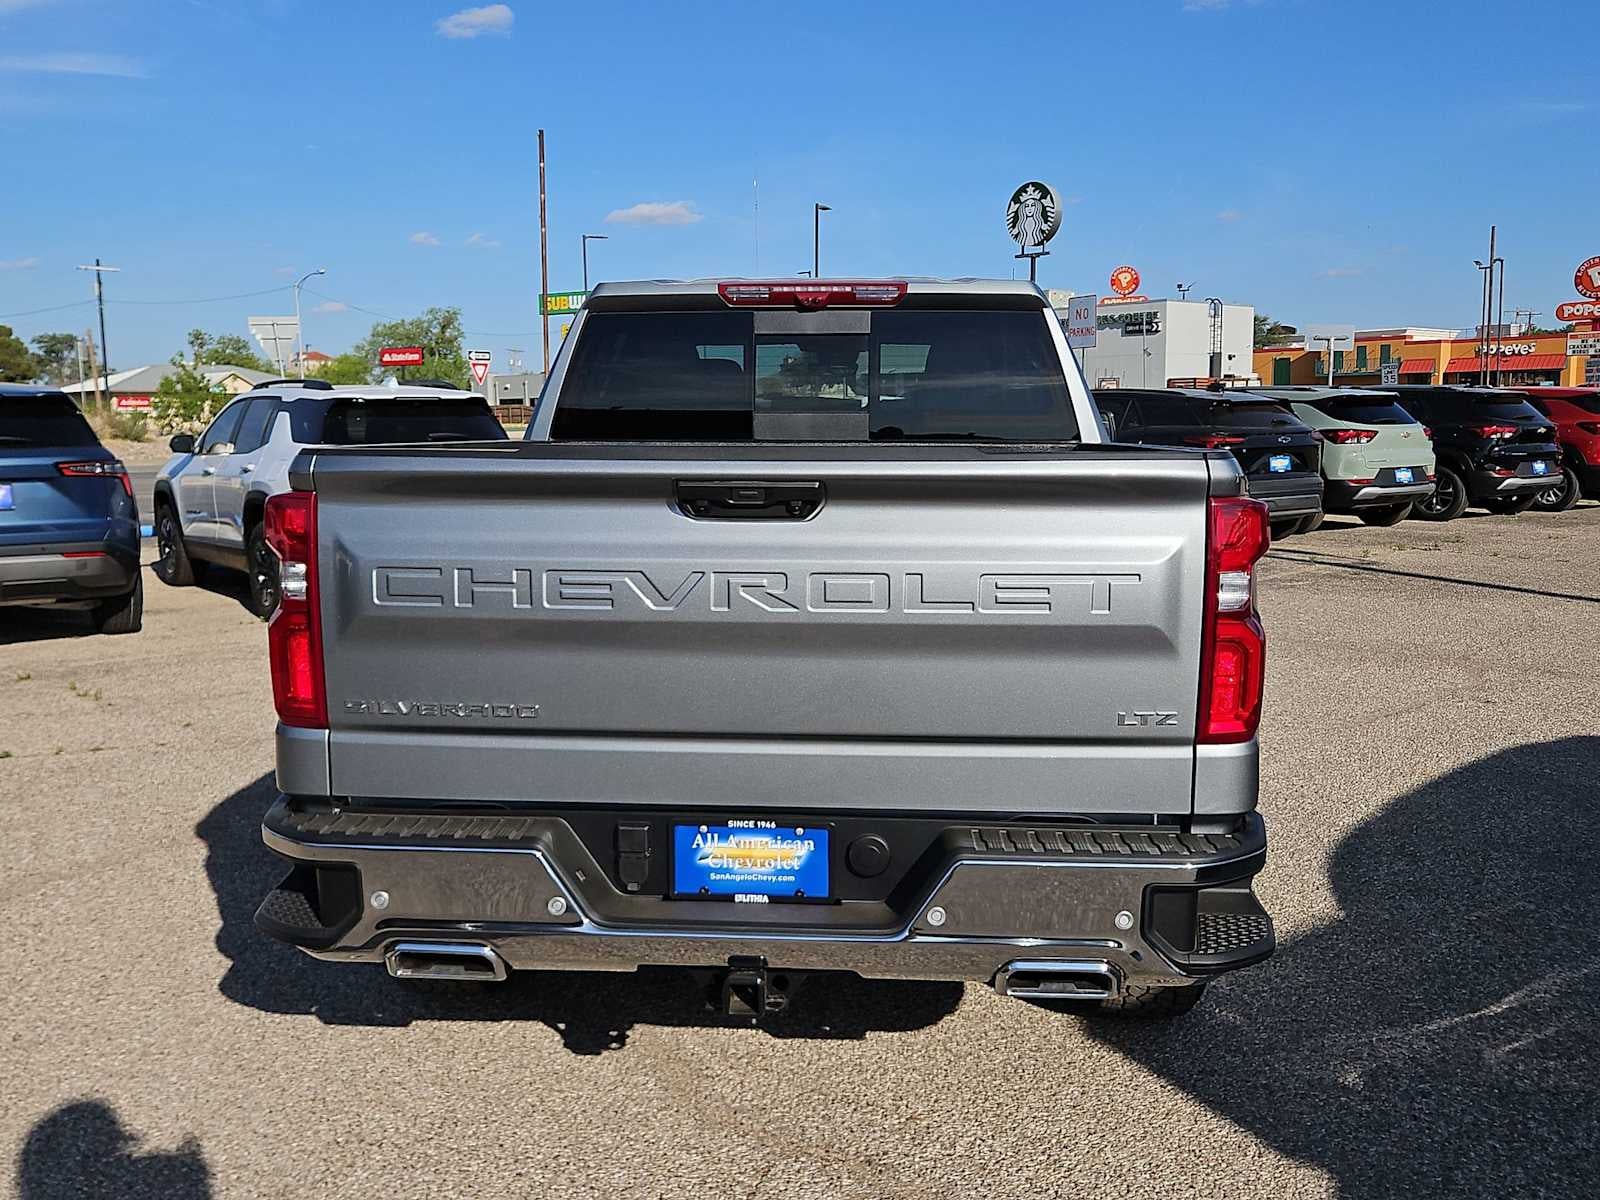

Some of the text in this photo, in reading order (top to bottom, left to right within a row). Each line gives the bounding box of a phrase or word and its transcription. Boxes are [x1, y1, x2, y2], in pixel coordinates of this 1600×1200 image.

[1075, 308, 1089, 321] NO
[1069, 326, 1095, 338] PARKING
[1383, 375, 1397, 384] 35
[371, 566, 1141, 615] CHEVROLET
[344, 700, 541, 718] SILVERADO
[1117, 711, 1179, 726] LTZ
[727, 820, 755, 829] SINCE
[691, 832, 816, 852] All American
[708, 853, 801, 870] Chevrolet
[710, 872, 796, 882] SanAngeloChevy.com
